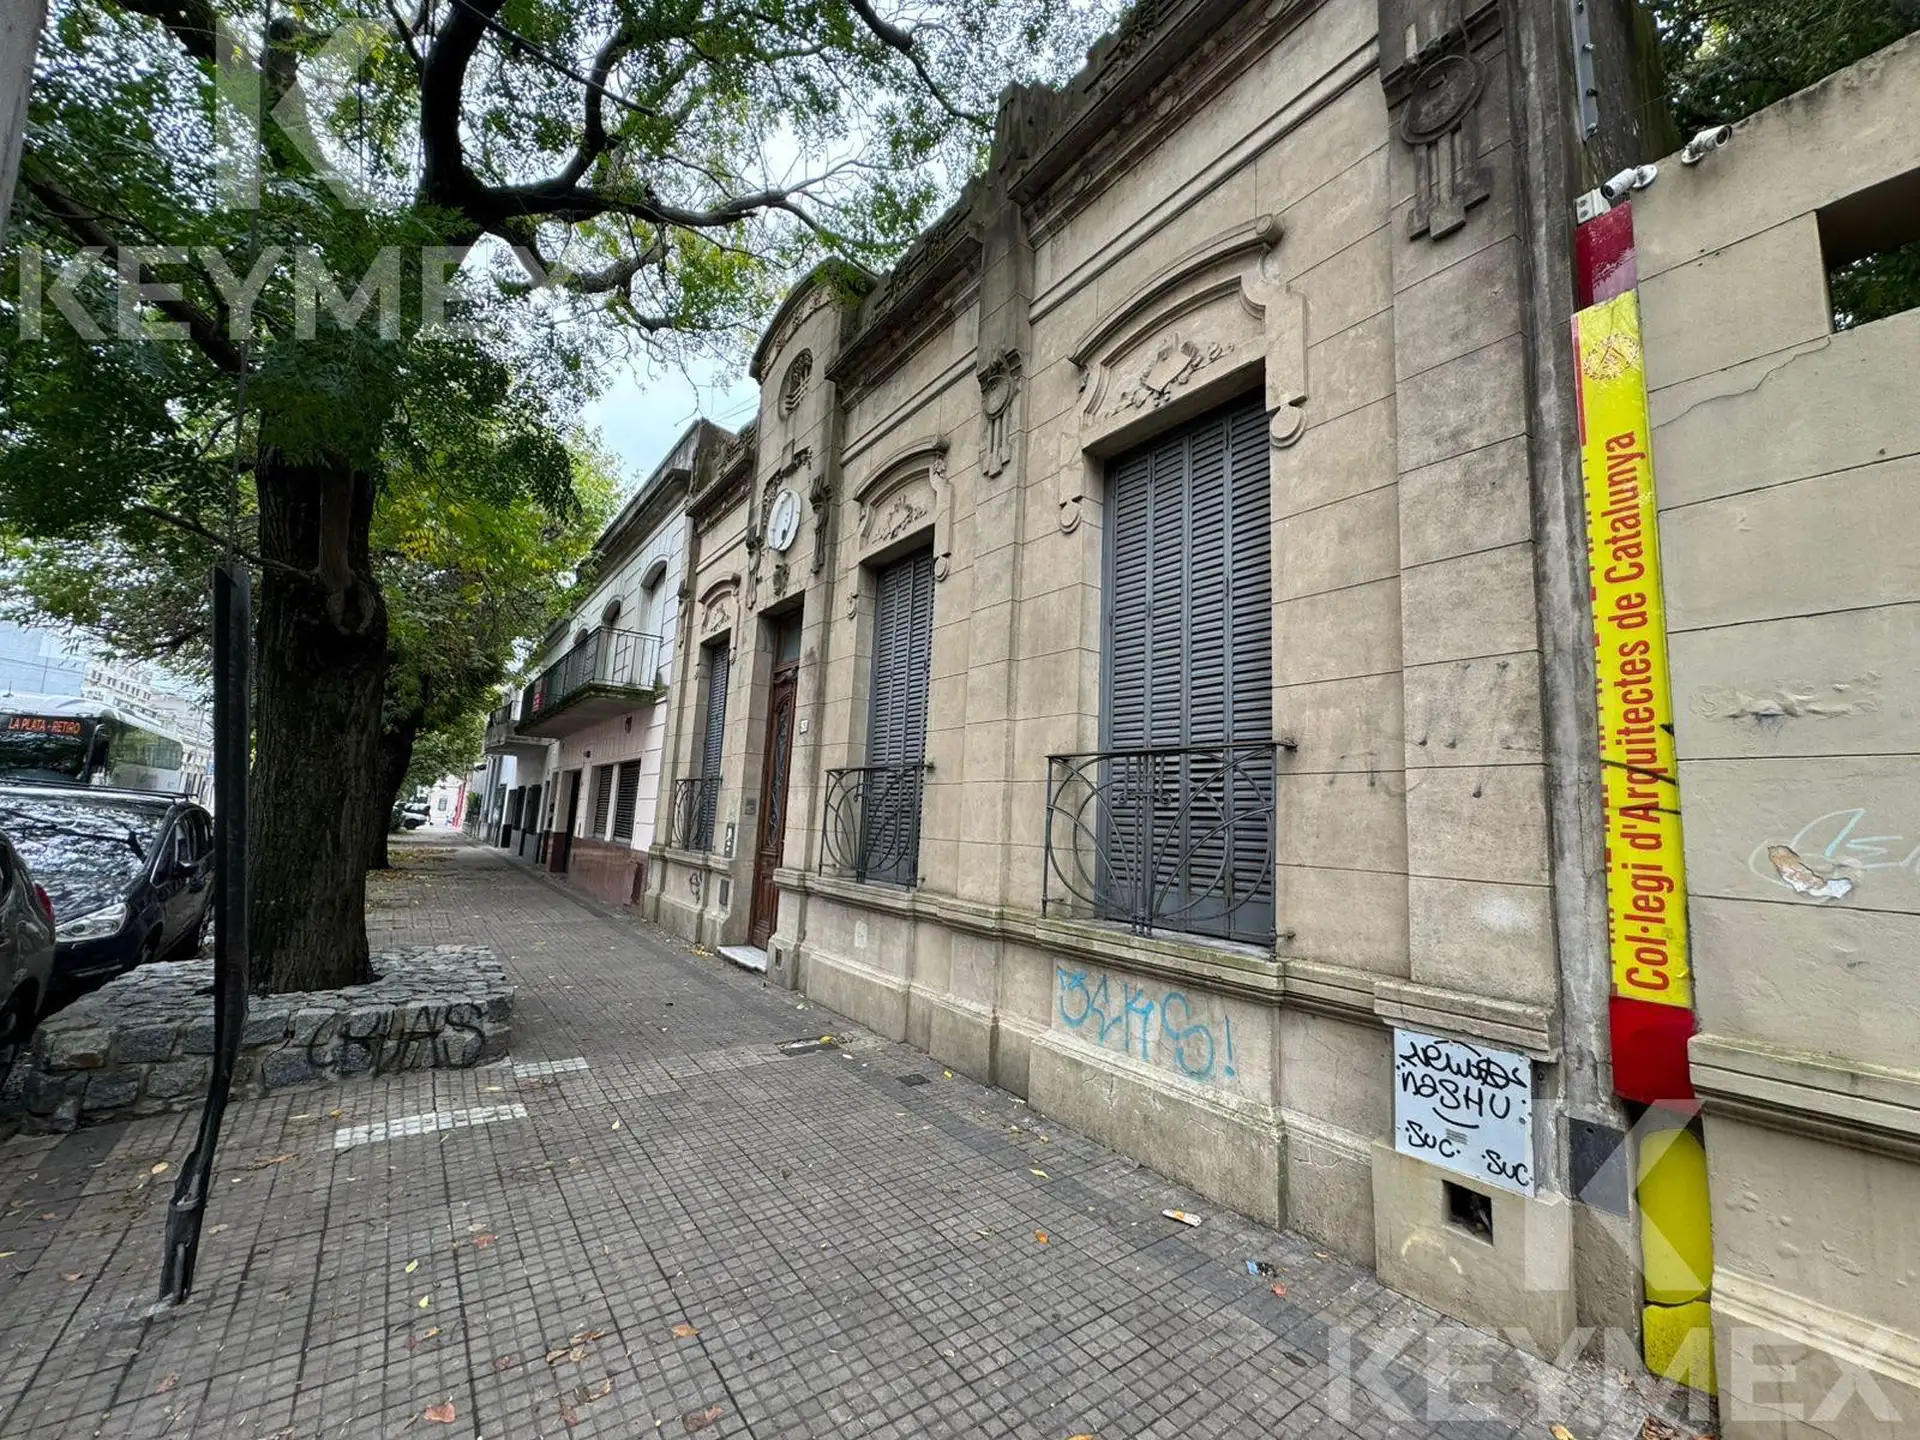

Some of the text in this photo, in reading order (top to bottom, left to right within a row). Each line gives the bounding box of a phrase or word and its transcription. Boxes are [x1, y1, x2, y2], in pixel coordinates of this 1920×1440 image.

[1601, 430, 1646, 585] Catalunya
[1608, 591, 1648, 631] de
[8, 717, 20, 730] LA
[20, 717, 46, 732] PLATA
[51, 720, 81, 734] RETIRO
[1614, 639, 1669, 851] d'Arquitectes
